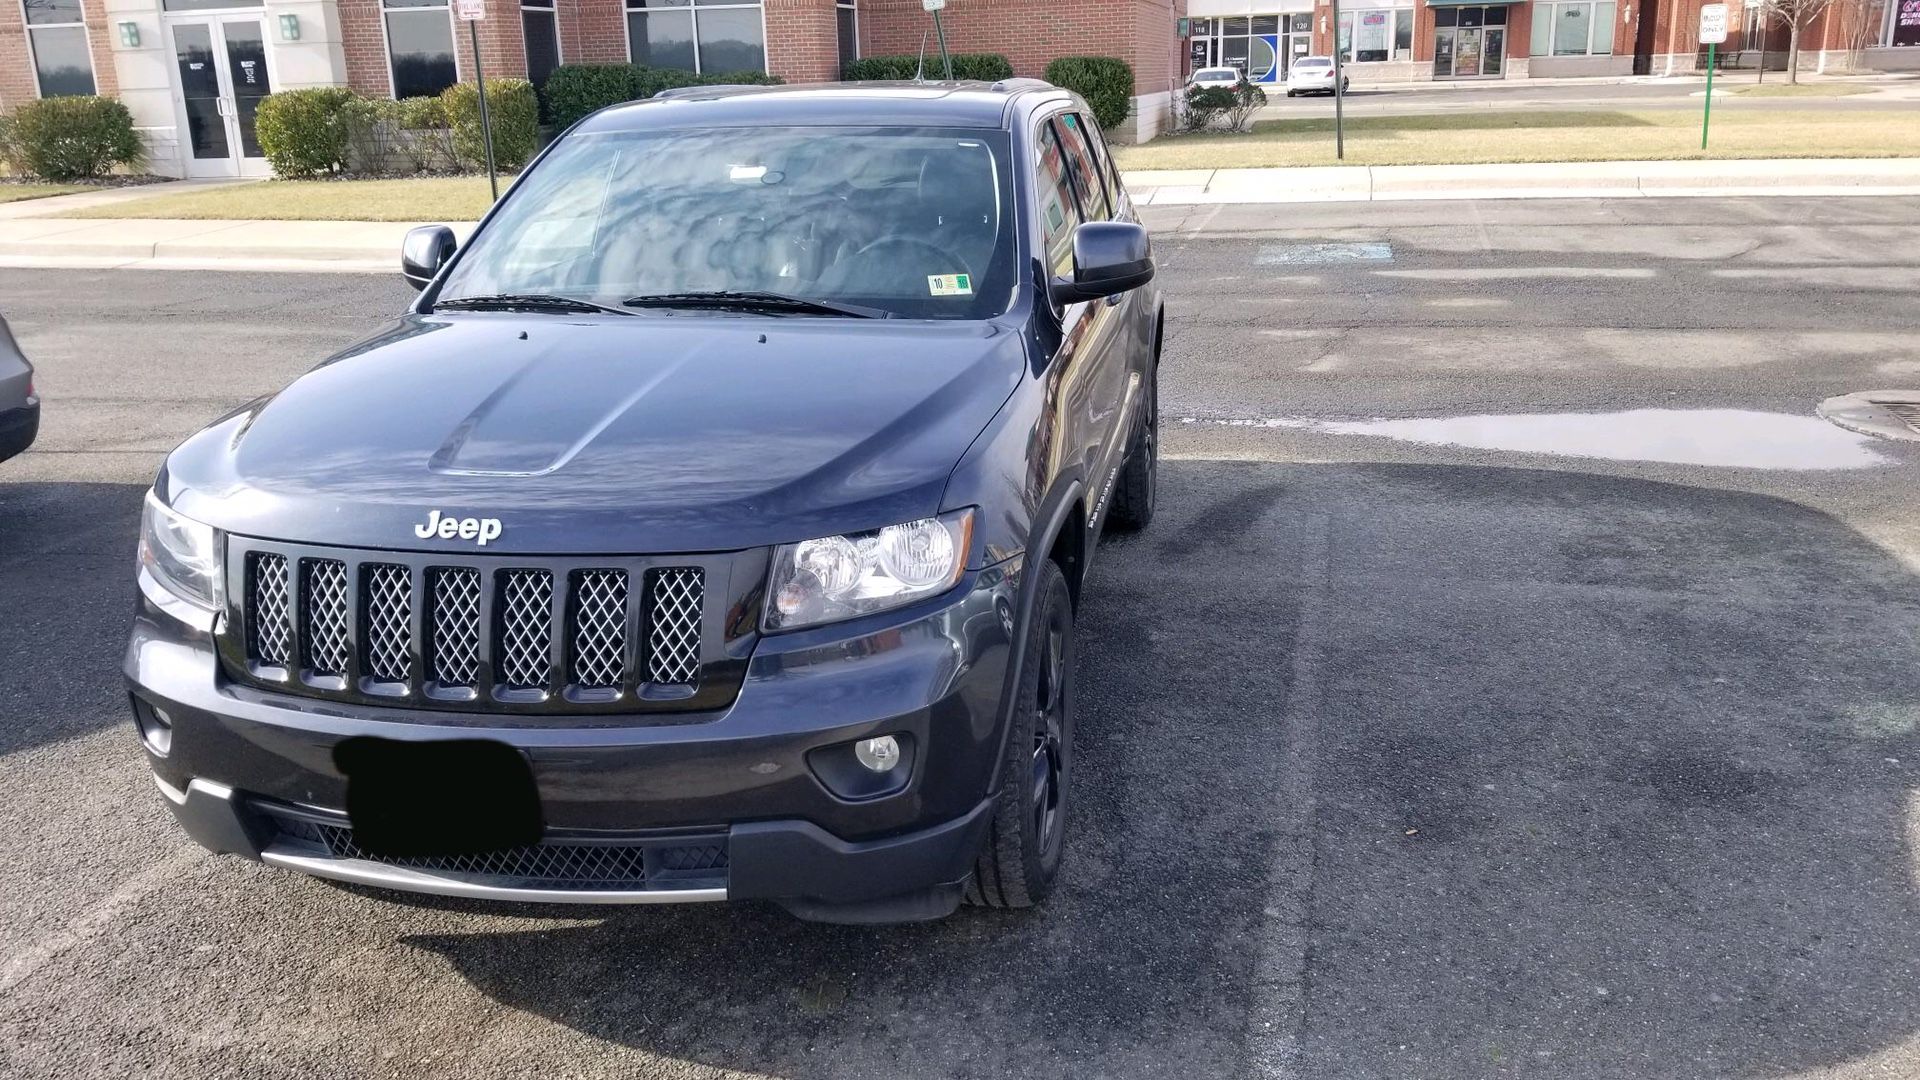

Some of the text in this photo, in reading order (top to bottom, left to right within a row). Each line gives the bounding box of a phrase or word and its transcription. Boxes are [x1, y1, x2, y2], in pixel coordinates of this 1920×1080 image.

[1296, 22, 1308, 30] 120
[934, 277, 943, 289] 10
[415, 510, 503, 546] Jeep
